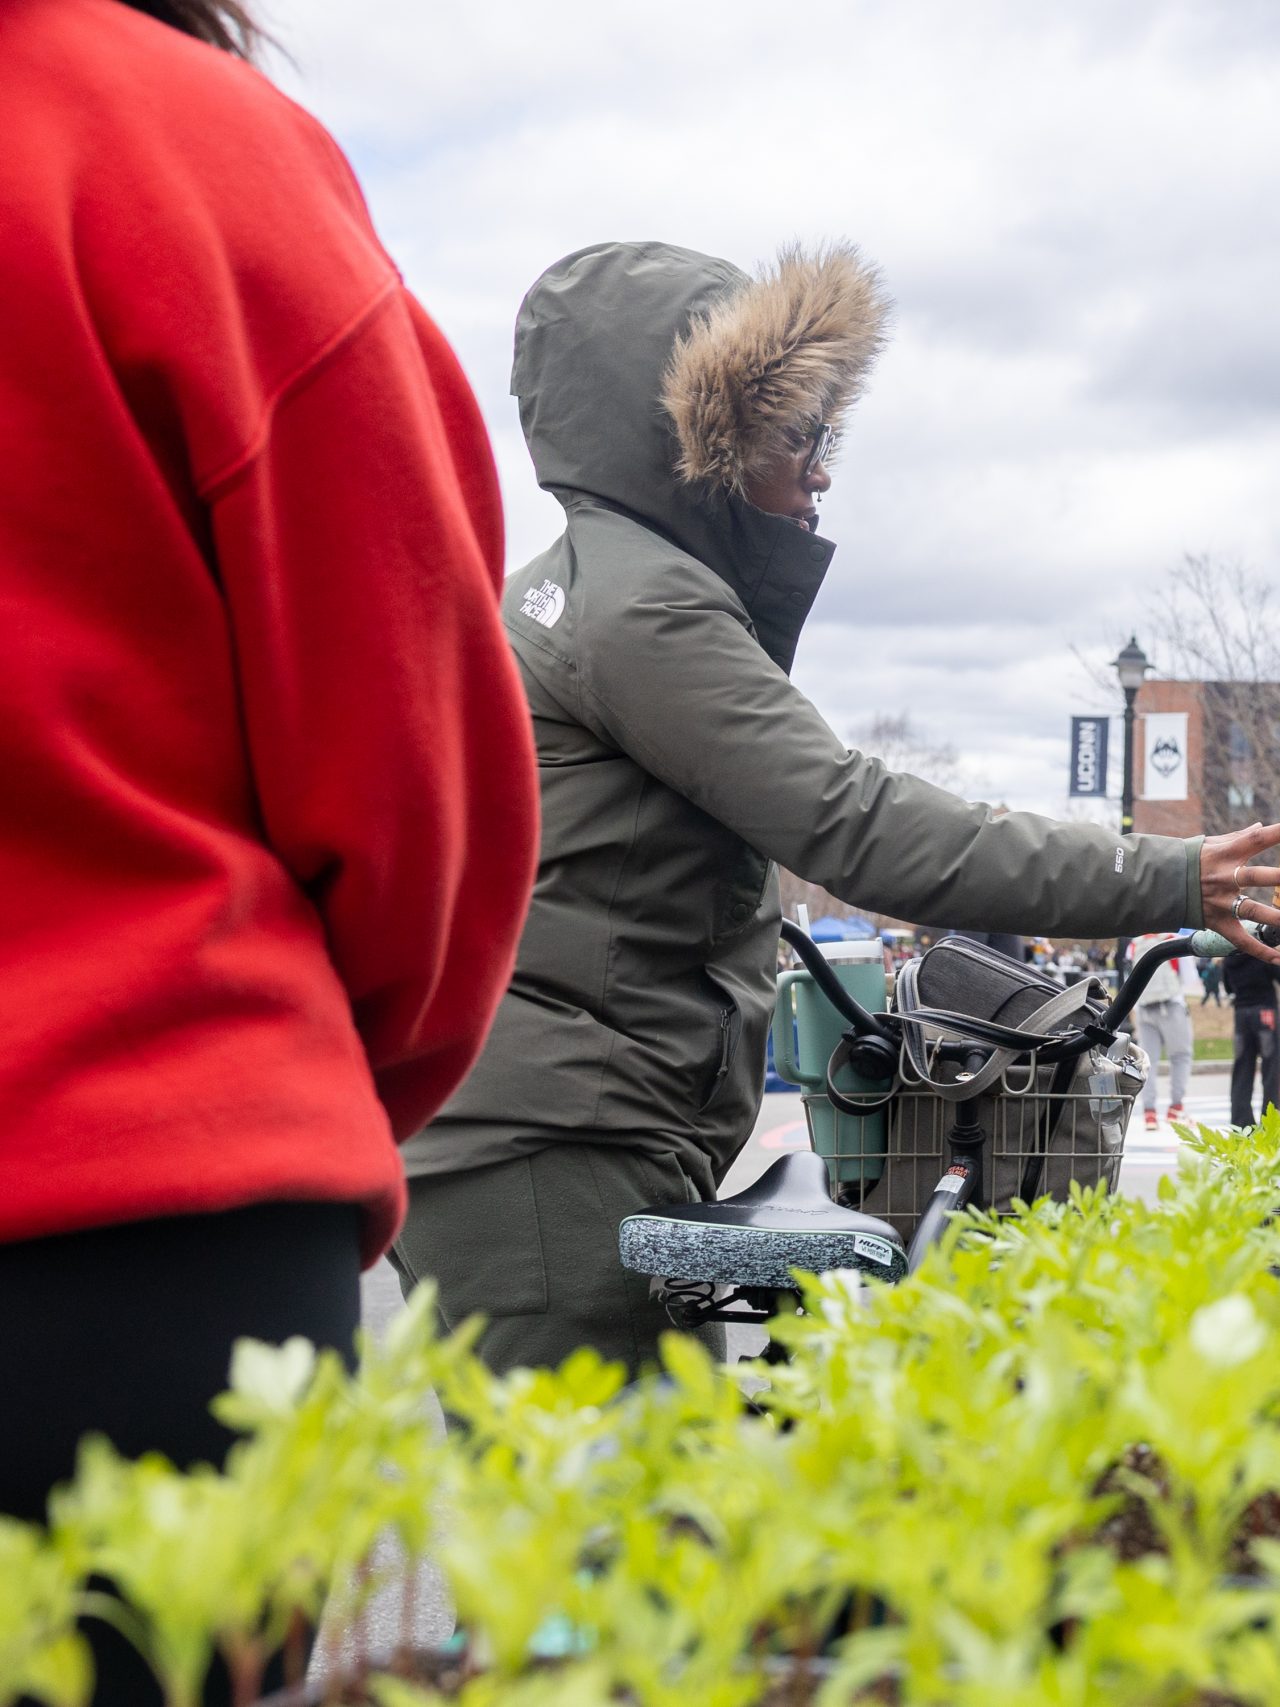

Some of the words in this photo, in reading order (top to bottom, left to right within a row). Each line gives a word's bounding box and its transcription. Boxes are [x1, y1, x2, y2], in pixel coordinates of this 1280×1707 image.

[540, 578, 558, 597] THE
[523, 587, 550, 609] NORTH
[519, 601, 542, 619] FACE
[1077, 721, 1096, 792] UCONN
[1114, 847, 1124, 873] 550
[858, 1239, 889, 1254] HUFFY
